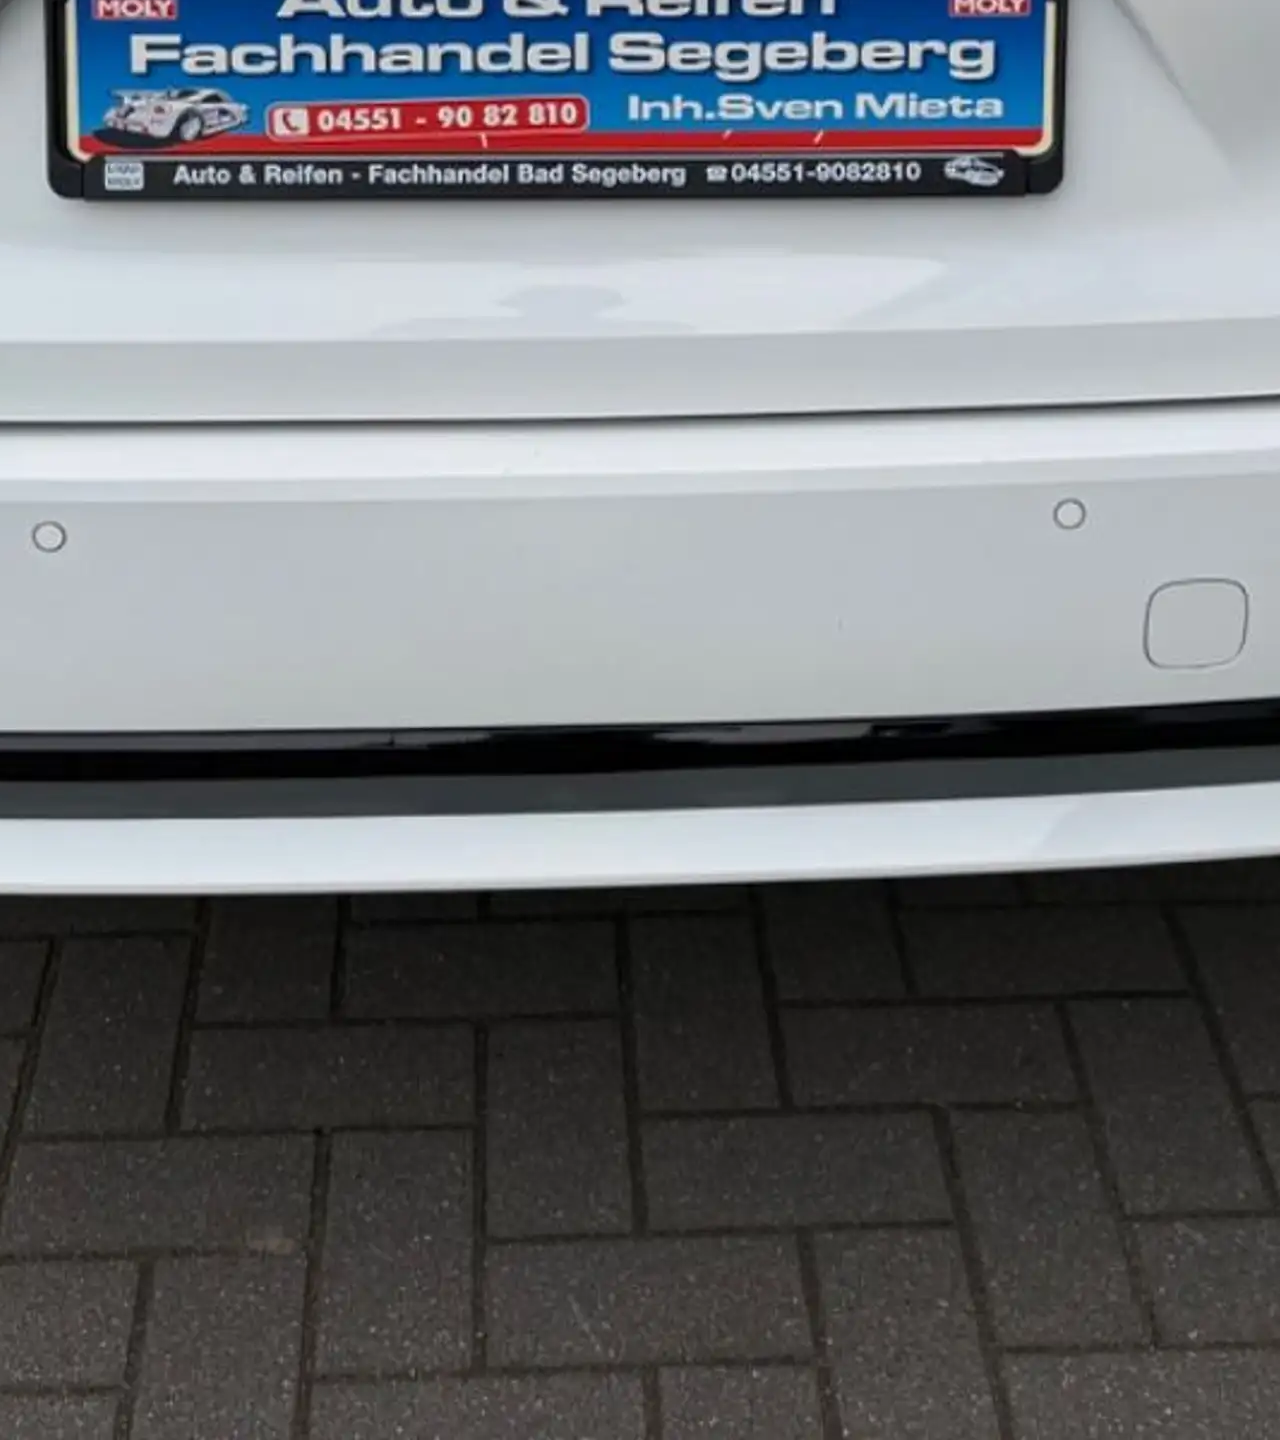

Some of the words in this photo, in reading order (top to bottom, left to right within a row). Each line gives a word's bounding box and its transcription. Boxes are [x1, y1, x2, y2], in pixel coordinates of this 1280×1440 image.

[94, 0, 175, 19] MOLY
[129, 33, 588, 76] Fachhandel
[608, 32, 997, 80] Segeberg
[318, 108, 402, 133] 04551
[437, 107, 473, 130] 90
[483, 106, 519, 129] 82
[527, 104, 576, 128] 810
[627, 94, 844, 122] Inh.Sven
[854, 94, 1004, 121] Mieta
[173, 166, 231, 186] Auto
[239, 166, 257, 185] &
[263, 165, 343, 186] Reifen
[368, 164, 510, 185] Fachhandel
[517, 165, 565, 184] Bad
[572, 164, 687, 187] Segeberg
